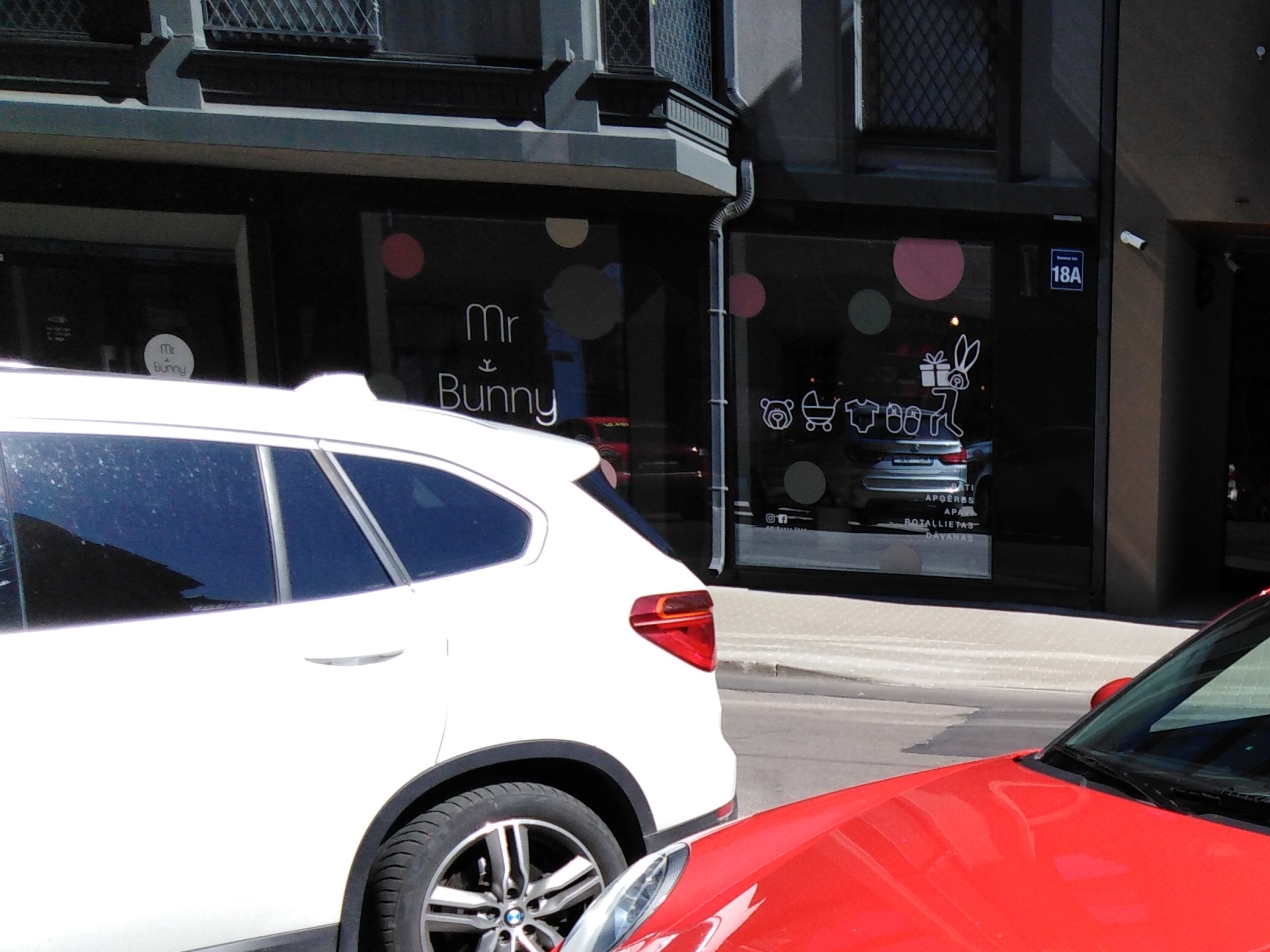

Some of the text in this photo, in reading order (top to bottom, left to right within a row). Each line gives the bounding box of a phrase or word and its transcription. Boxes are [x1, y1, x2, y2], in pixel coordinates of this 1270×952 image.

[1052, 265, 1082, 284] 18A
[466, 303, 520, 343] Mr
[160, 343, 175, 355] Mr
[153, 361, 187, 377] Bunny
[438, 372, 558, 426] Bunny
